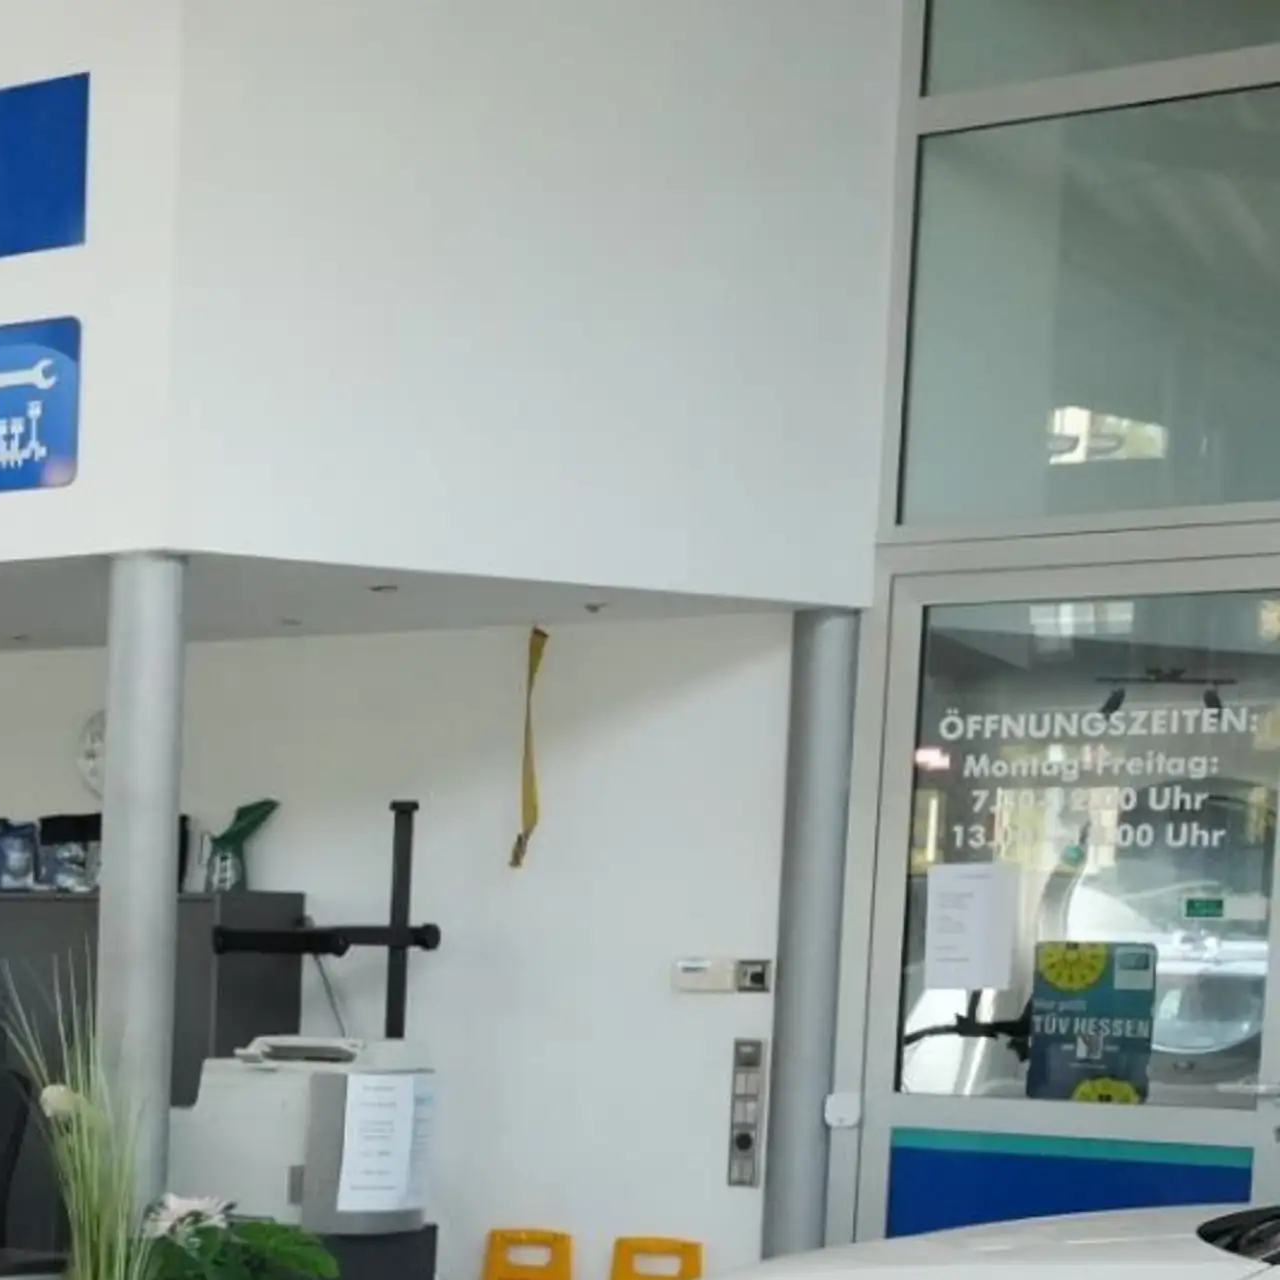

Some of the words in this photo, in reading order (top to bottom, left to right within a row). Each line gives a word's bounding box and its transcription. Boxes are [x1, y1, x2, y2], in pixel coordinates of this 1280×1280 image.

[939, 707, 1258, 741] ÖFFNUNGSZEITEN:
[1147, 785, 1210, 812] Uhr
[1164, 823, 1227, 848] Uhr
[1031, 1012, 1071, 1036] TÜV
[1073, 1016, 1151, 1039] HESSEN
